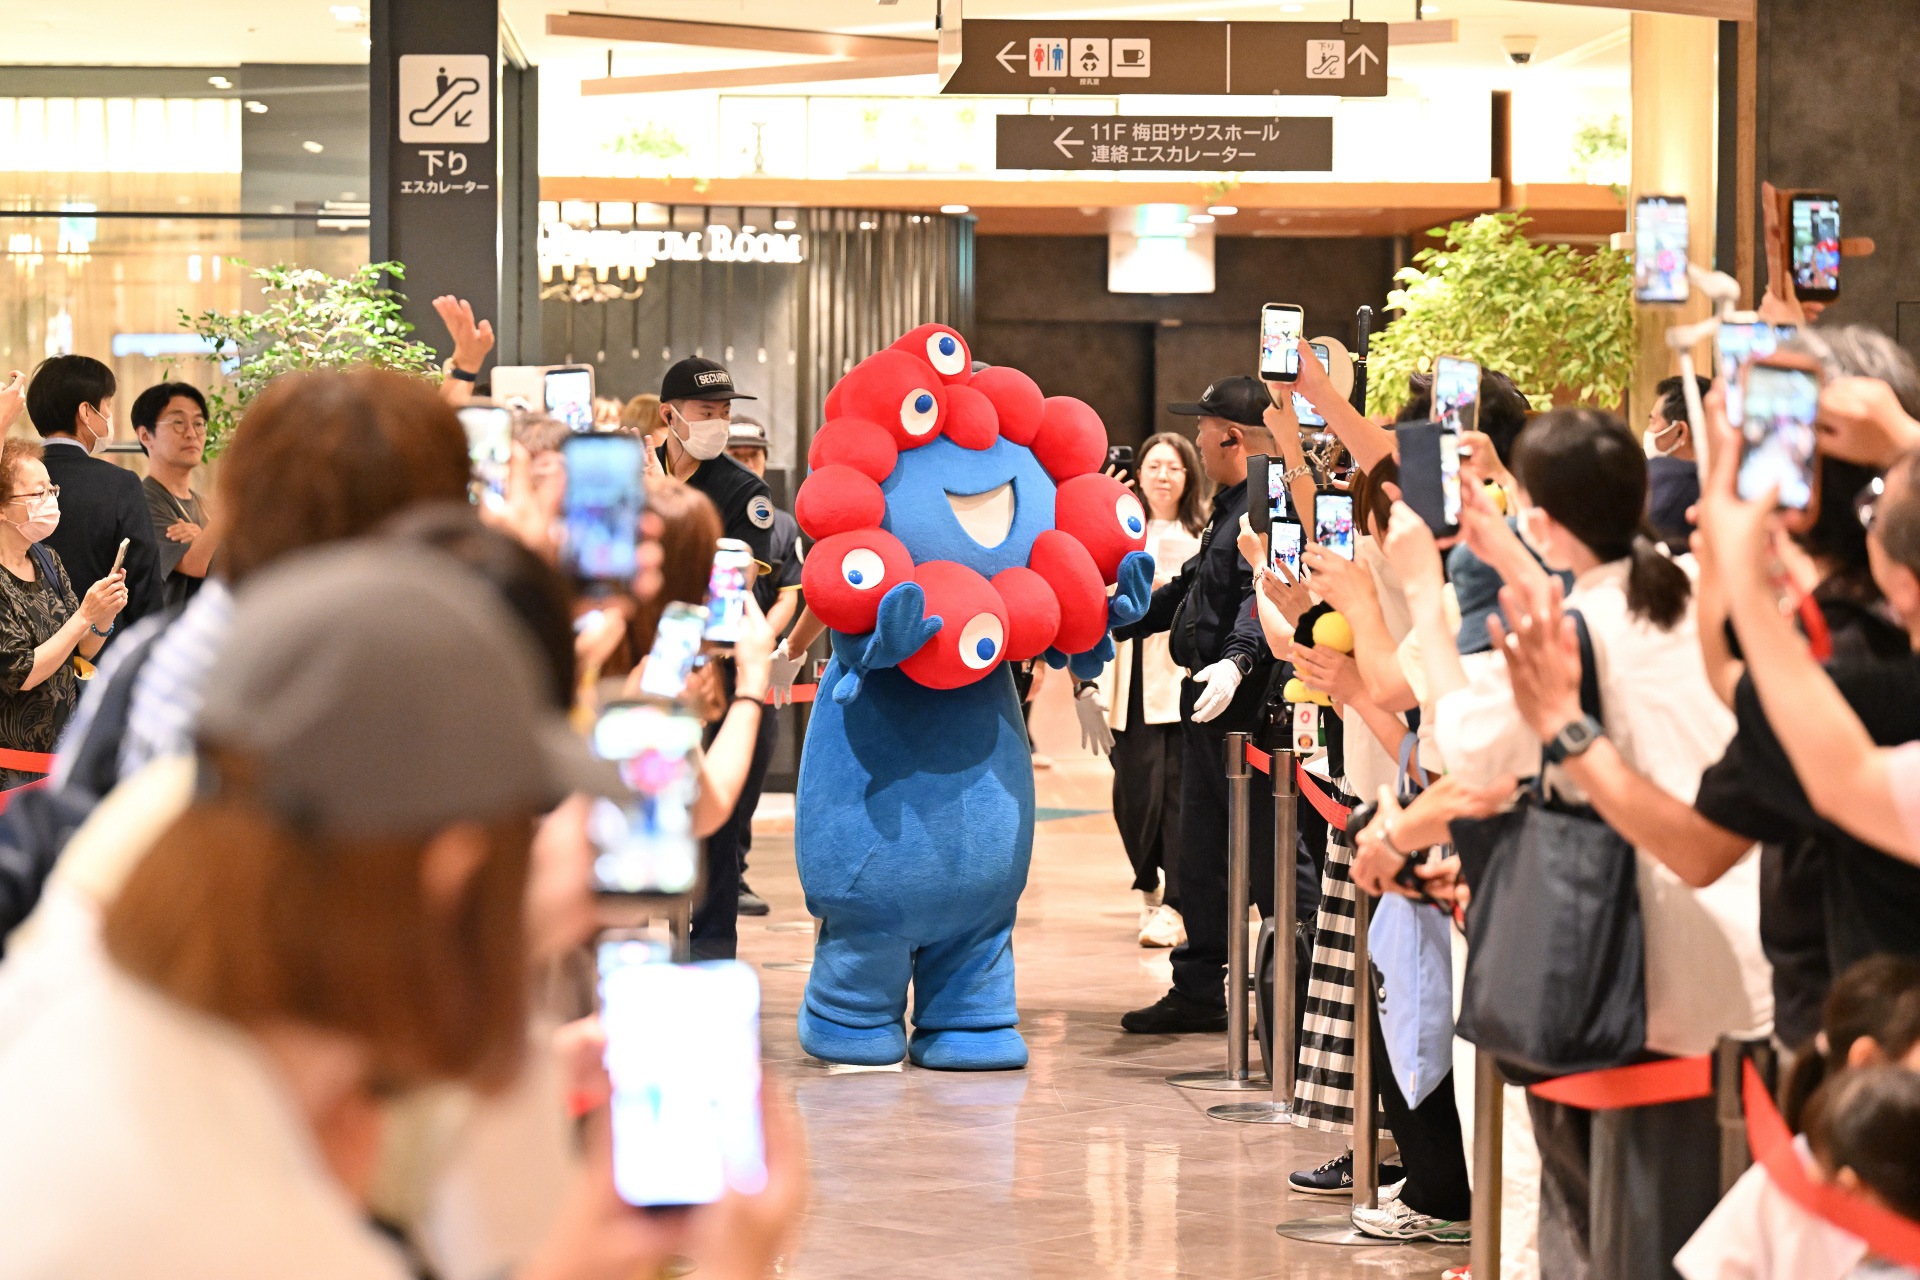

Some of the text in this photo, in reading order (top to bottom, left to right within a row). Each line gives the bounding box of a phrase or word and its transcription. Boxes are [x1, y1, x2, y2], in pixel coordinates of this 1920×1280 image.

[1318, 42, 1335, 51] 下り
[1091, 123, 1280, 141] 11F 梅田サウスホール
[1091, 145, 1257, 163] 連絡エスカレーター
[418, 150, 468, 177] 下り
[400, 180, 490, 195] エスカレーター
[707, 224, 803, 263] ROOM
